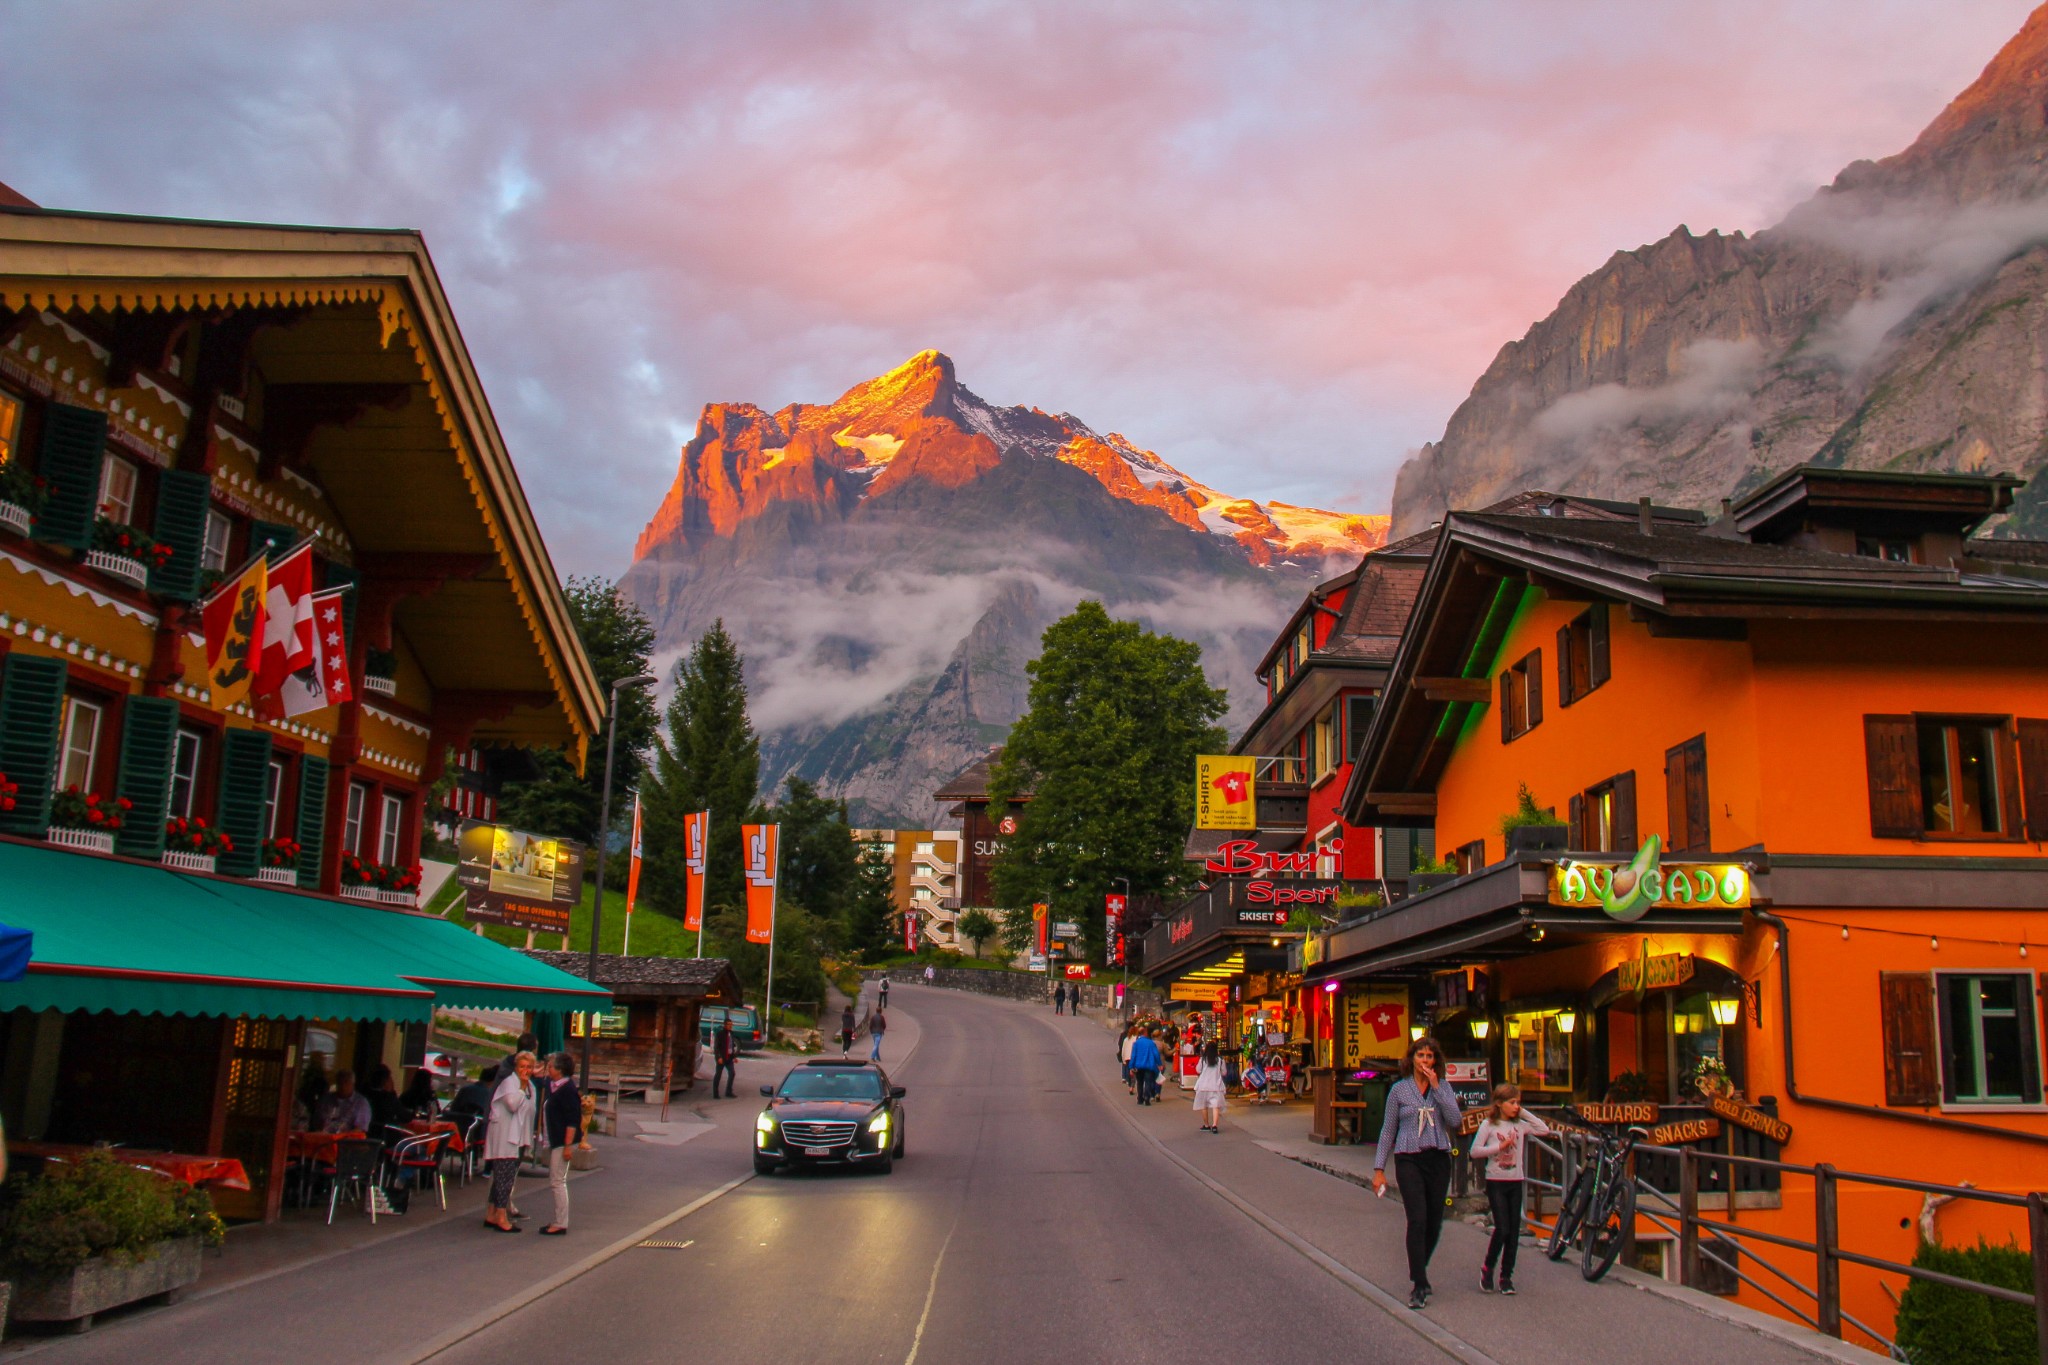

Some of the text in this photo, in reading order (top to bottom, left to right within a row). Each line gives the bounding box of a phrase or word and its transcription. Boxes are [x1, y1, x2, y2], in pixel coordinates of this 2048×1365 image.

[1200, 763, 1210, 827] T-SHIRTS
[1205, 837, 1345, 873] Buri
[1247, 880, 1340, 906] Sport
[1239, 912, 1275, 922] SKISET
[1453, 1090, 1487, 1101] elcome
[1583, 1105, 1651, 1122] BILLIARDS
[1713, 1097, 1789, 1140] COLD DRINKS
[1654, 1121, 1709, 1144] SNACKS
